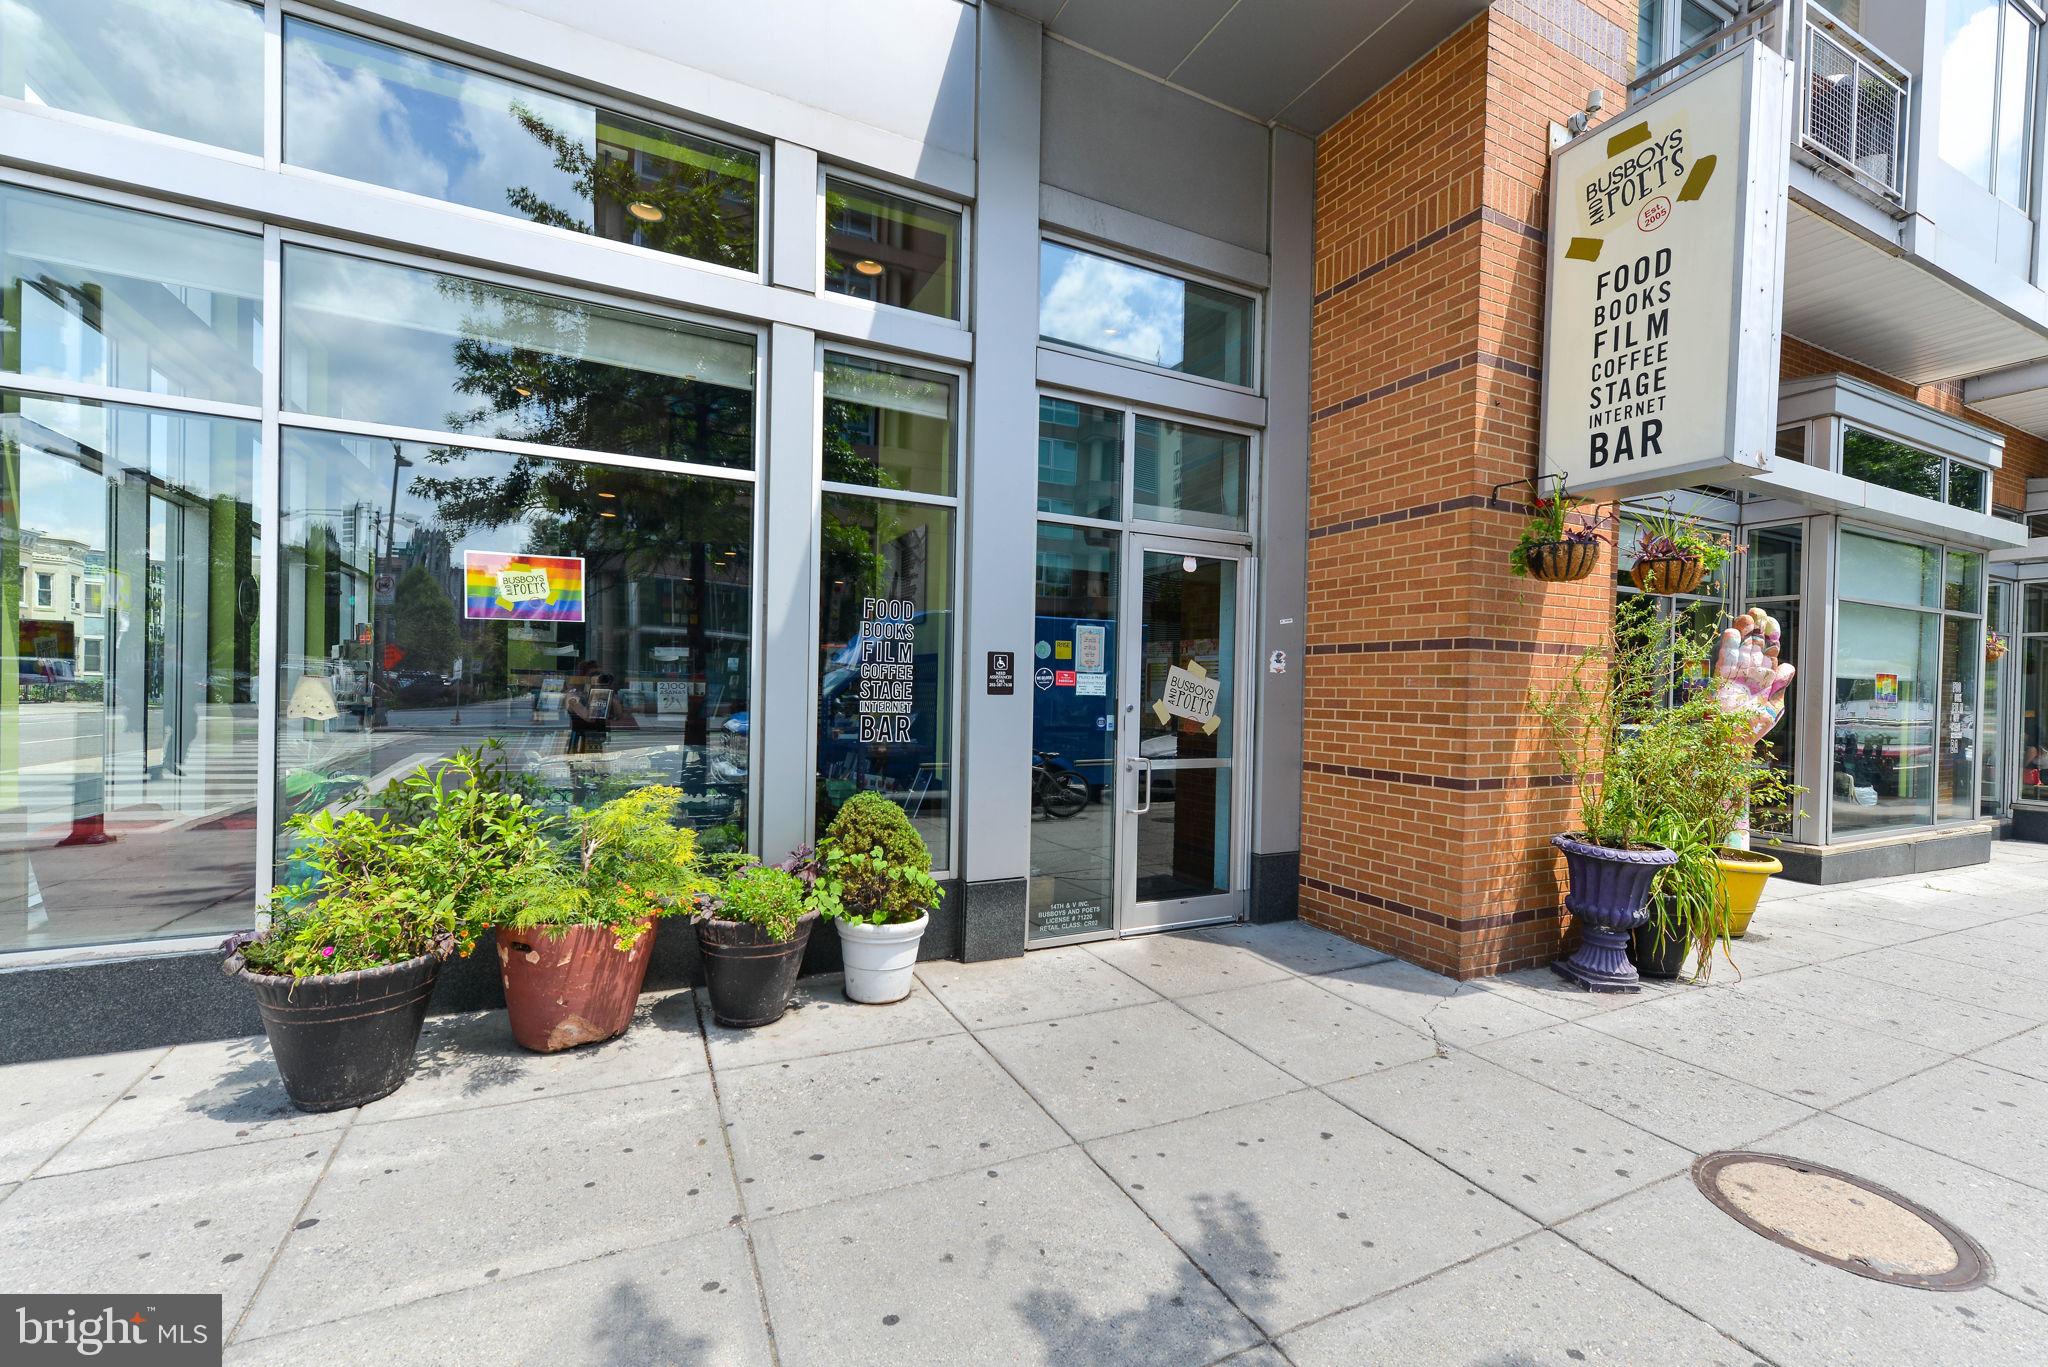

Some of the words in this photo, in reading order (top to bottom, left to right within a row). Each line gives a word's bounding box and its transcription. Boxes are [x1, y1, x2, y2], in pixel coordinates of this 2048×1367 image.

[1587, 129, 1682, 202] BUSBOYS
[1589, 198, 1604, 226] AND
[1604, 147, 1684, 218] POETS
[1644, 203, 1663, 218] Est.
[1644, 208, 1667, 227] 2005
[1597, 248, 1672, 301] FOOD
[1594, 281, 1671, 327] BOOKS
[1594, 308, 1669, 359] FILM
[1592, 341, 1668, 382] COFFEE
[1590, 366, 1667, 409] STAGE
[1589, 395, 1666, 429] INTERNET
[1590, 419, 1663, 469] BAR
[503, 574, 545, 585] BUSBOYS
[513, 582, 547, 595] POETS
[863, 597, 914, 621] FOOD
[861, 620, 915, 641] BOOKS
[861, 641, 914, 664] FILM
[860, 663, 914, 681] COFFEE
[859, 680, 913, 700] STAGE
[1171, 676, 1215, 700] BUSBOYS
[859, 700, 912, 714] INTERNET
[1168, 688, 1177, 705] AND
[1175, 690, 1213, 717] POETS
[859, 714, 911, 743] BAR
[1038, 910, 1066, 918] BUSBOYS
[1045, 917, 1070, 925] LICENSE
